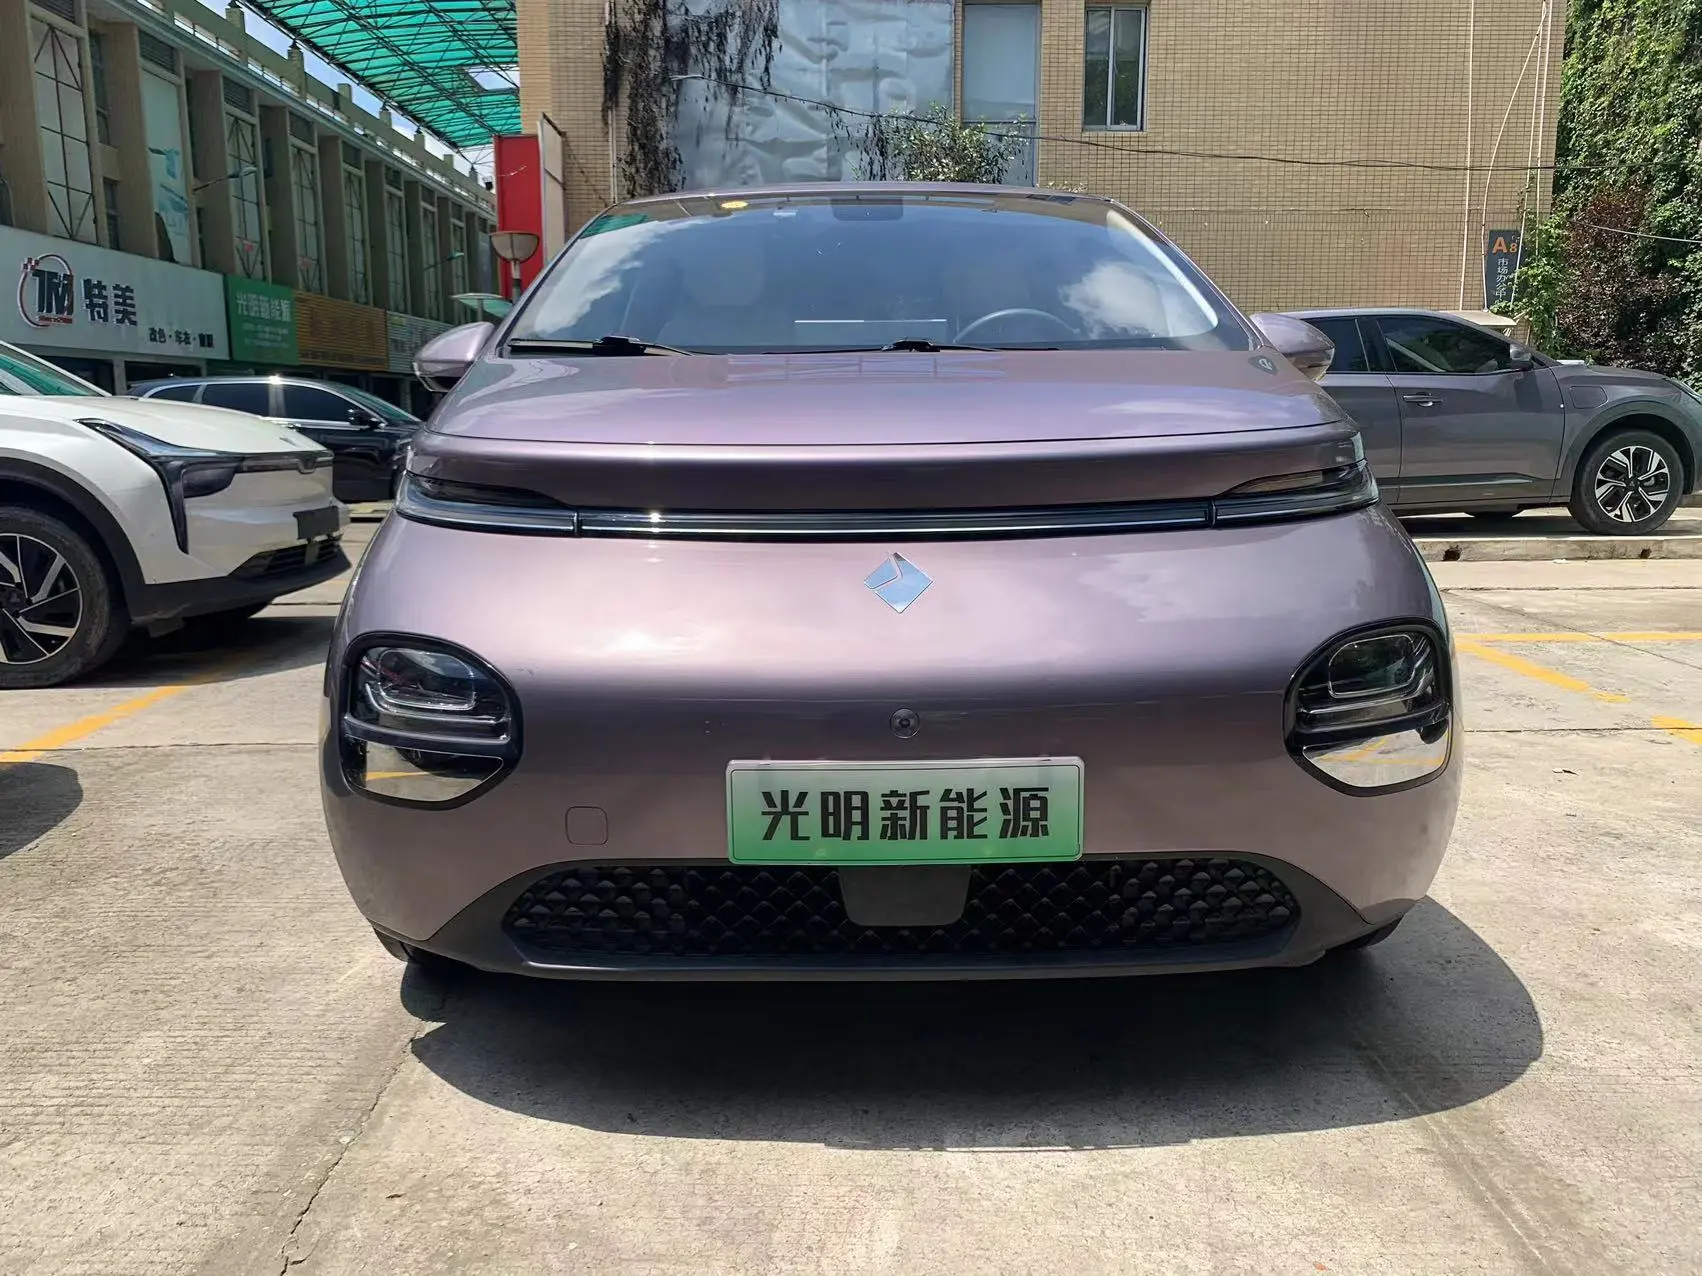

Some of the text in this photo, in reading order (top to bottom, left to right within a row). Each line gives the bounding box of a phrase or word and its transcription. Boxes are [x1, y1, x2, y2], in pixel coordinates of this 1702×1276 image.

[81, 278, 137, 326] 特美
[761, 787, 1049, 840] 光明新能源
